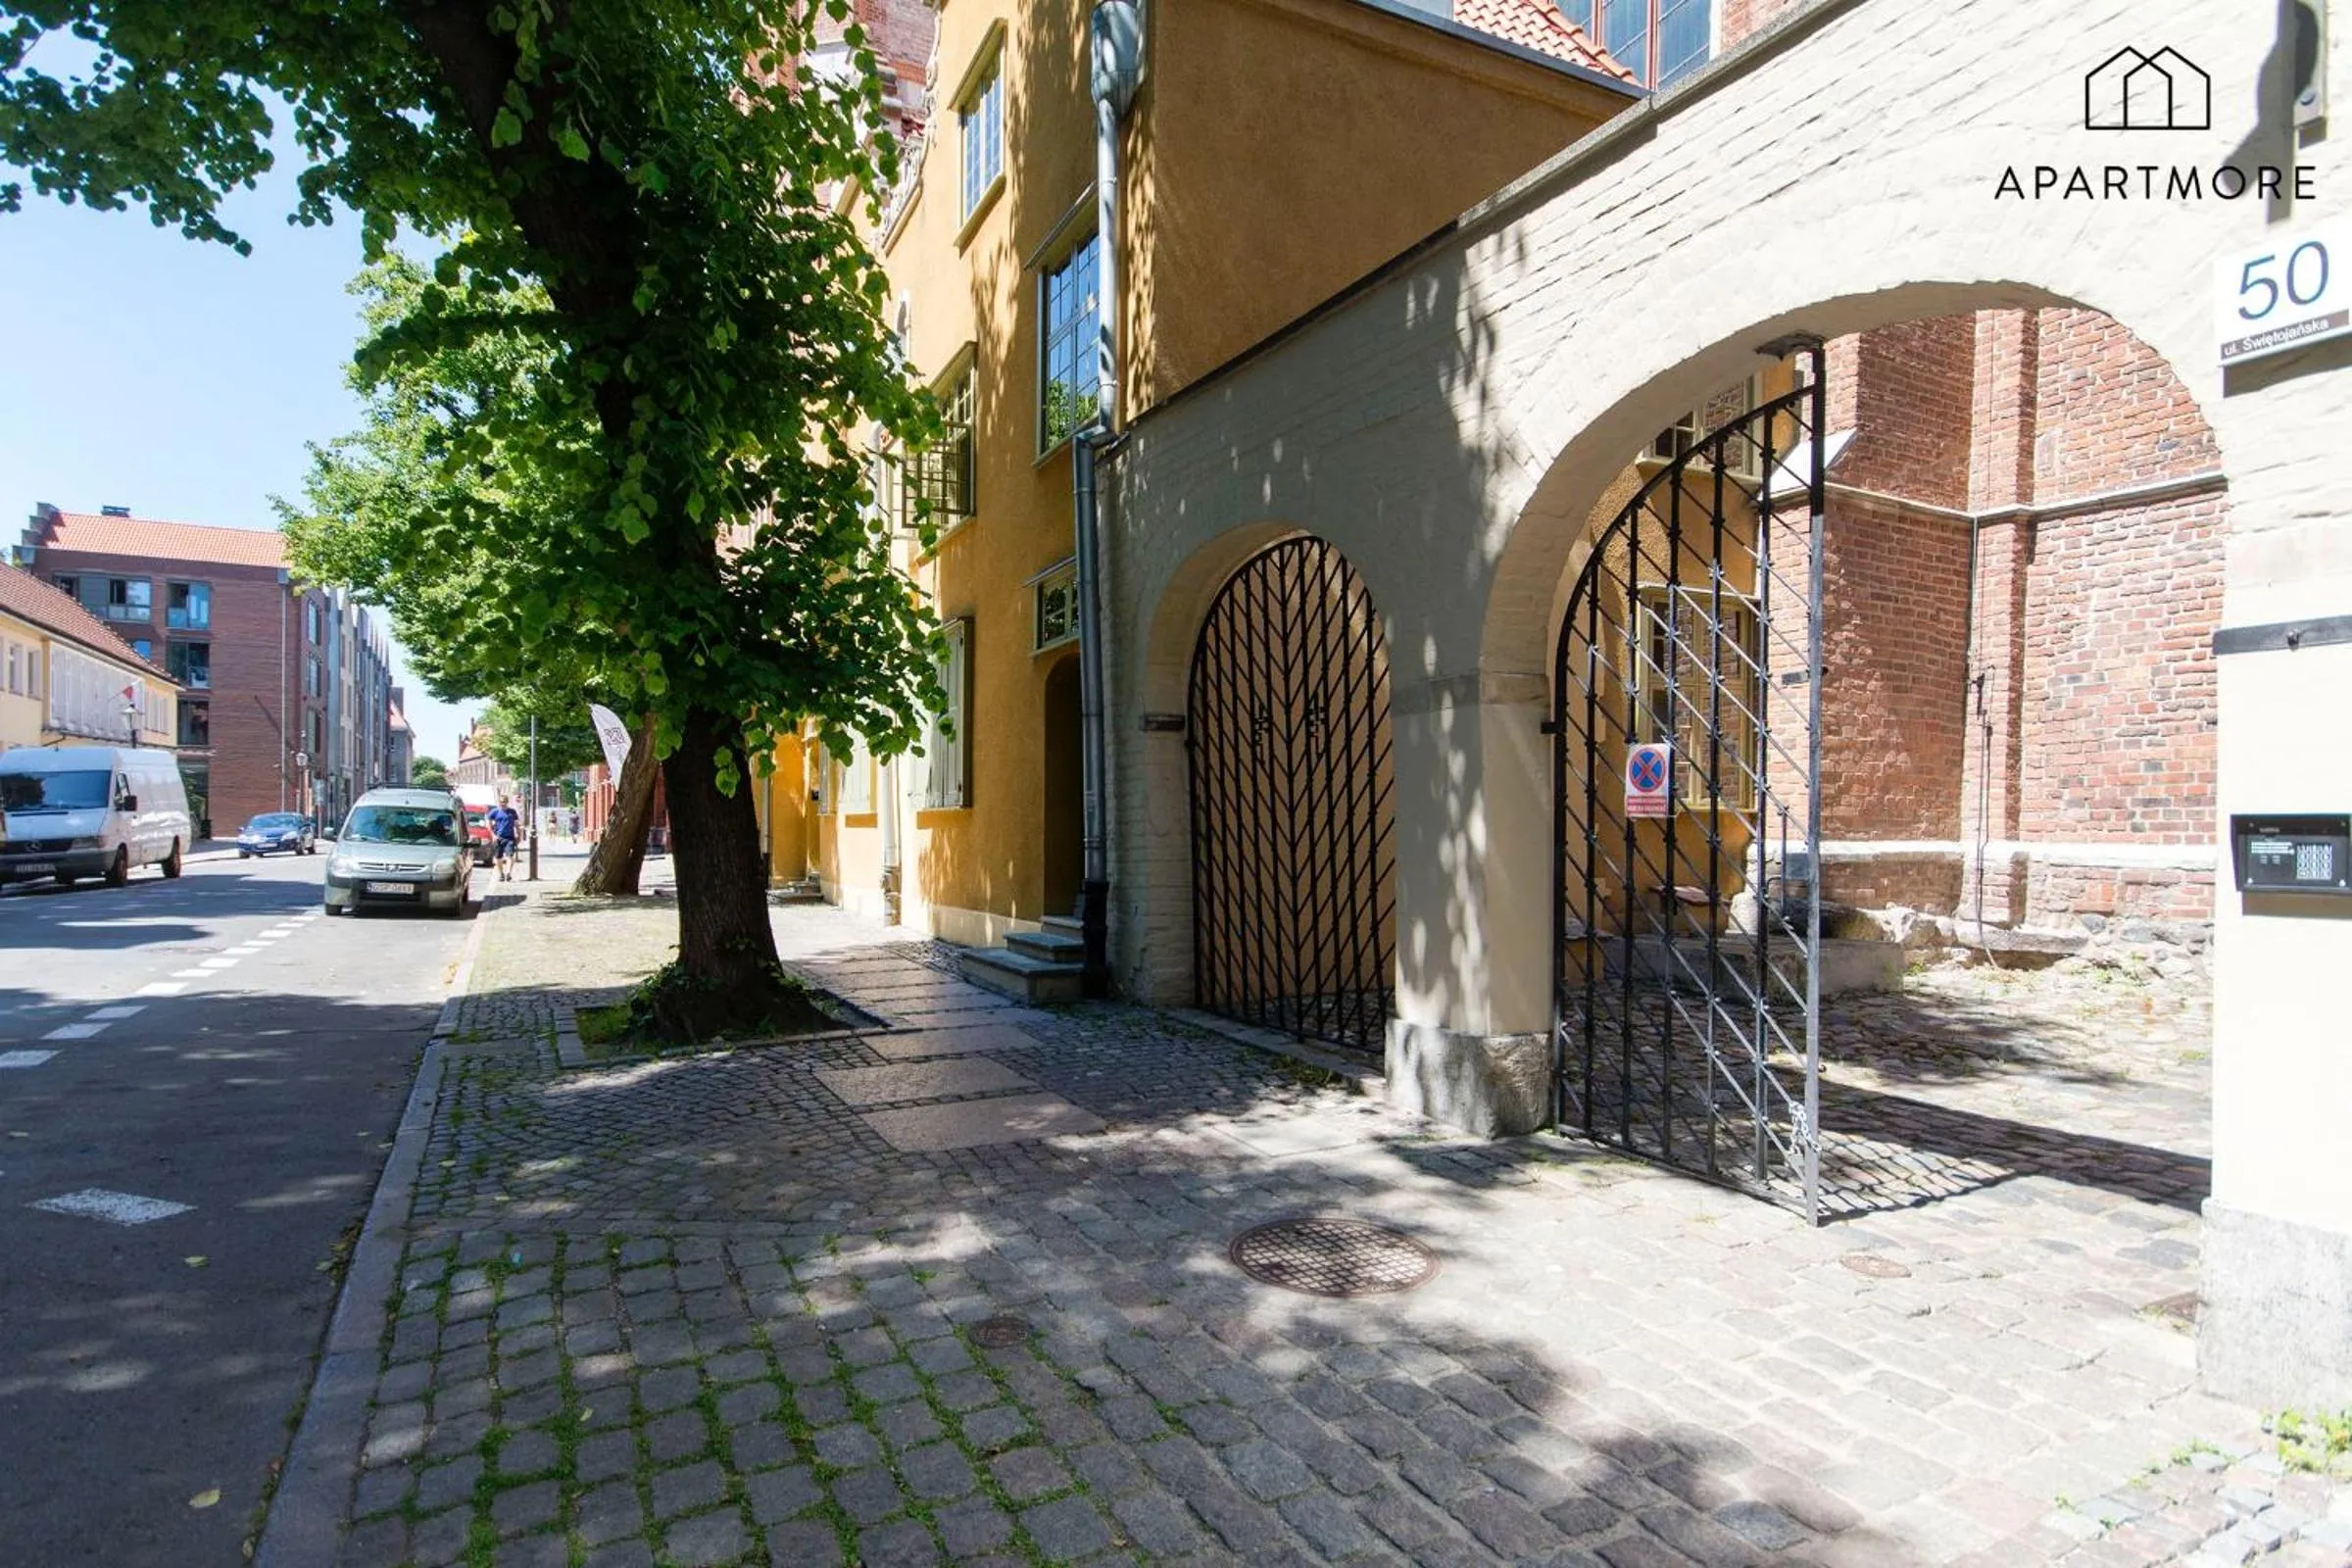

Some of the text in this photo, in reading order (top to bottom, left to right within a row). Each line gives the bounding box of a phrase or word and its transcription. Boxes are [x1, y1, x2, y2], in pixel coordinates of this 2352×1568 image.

[2237, 240, 2329, 321] 50
[2224, 318, 2329, 356] ul. Świętojańska
